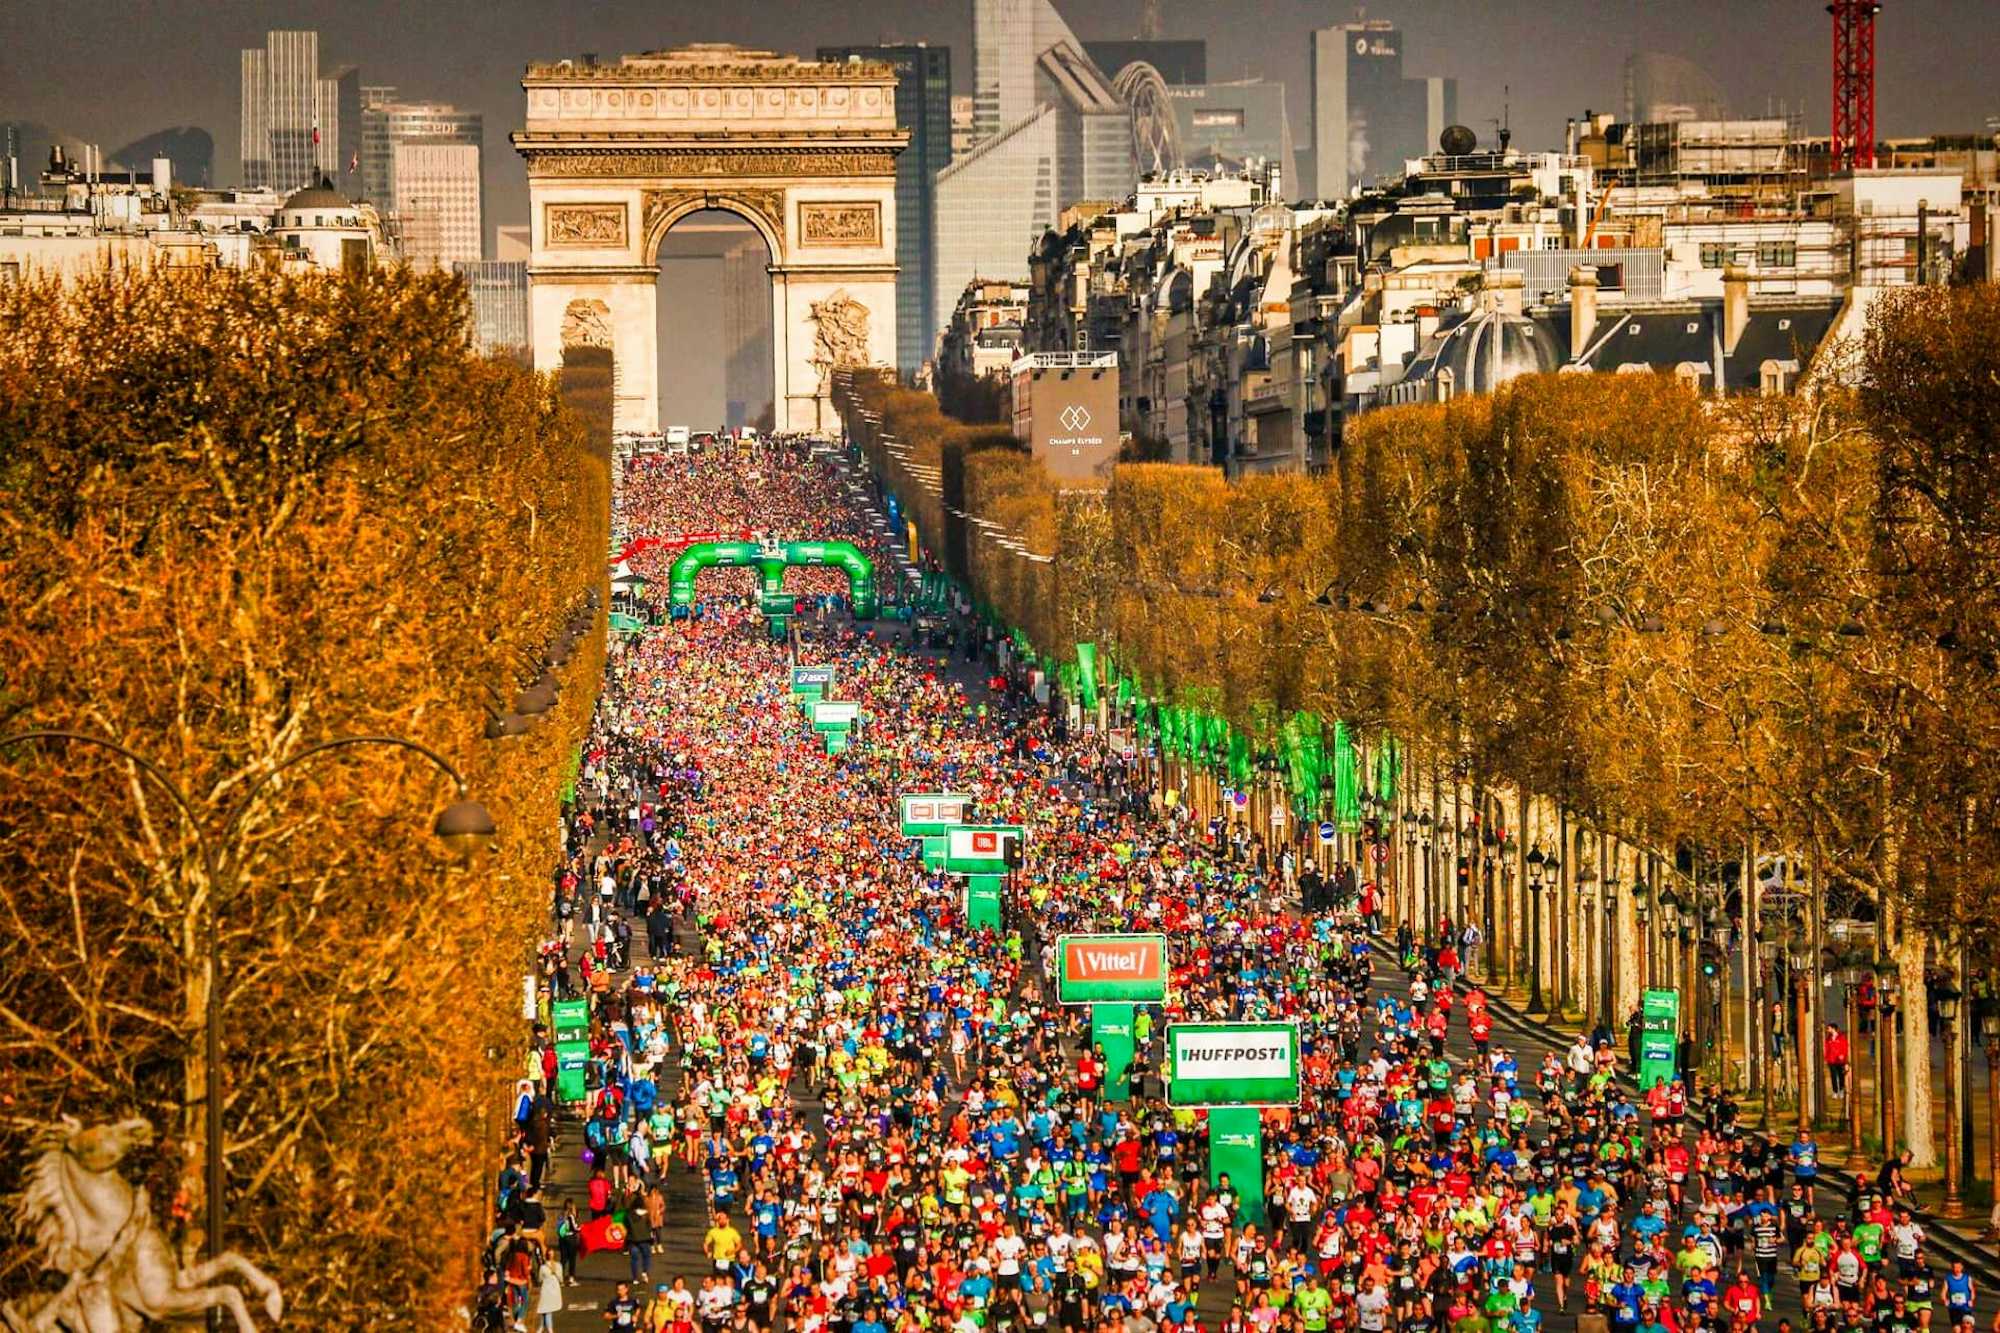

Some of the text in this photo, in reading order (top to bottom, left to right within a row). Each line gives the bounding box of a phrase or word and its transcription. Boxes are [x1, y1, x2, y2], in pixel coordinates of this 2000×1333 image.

[1049, 438, 1076, 446] CHAMPS
[1084, 950, 1139, 972] Vittel
[1644, 1019, 1669, 1031] Km 1
[557, 1028, 581, 1041] Km 1
[1187, 1047, 1279, 1062] HUFFPOST
